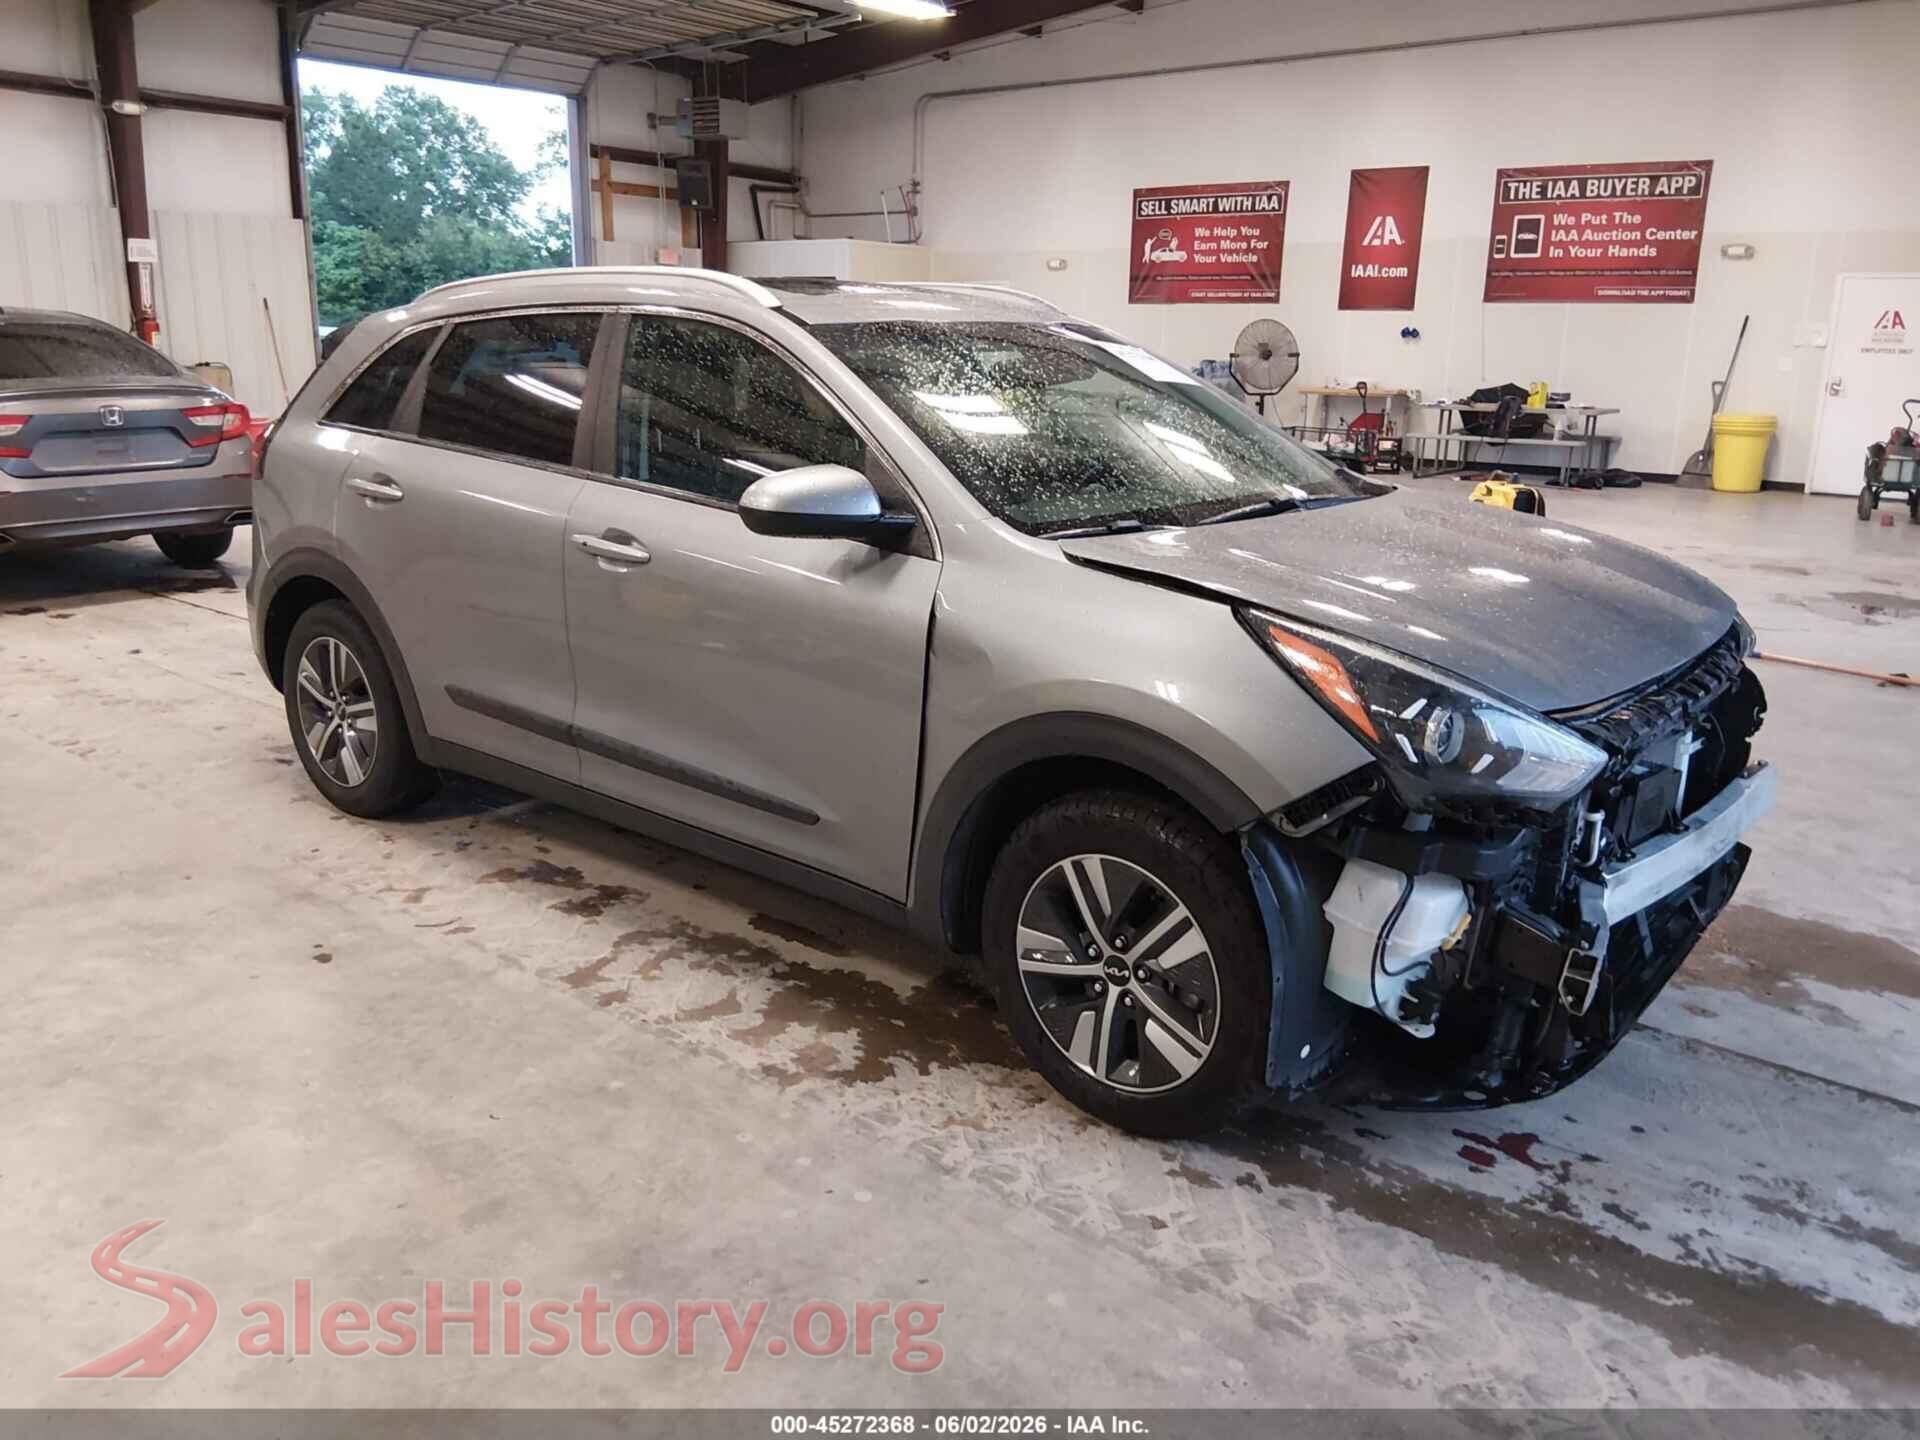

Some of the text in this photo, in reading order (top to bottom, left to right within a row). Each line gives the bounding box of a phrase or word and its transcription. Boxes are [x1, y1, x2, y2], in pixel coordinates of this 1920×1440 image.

[1507, 175, 1697, 201] THE IAA BUYER APP
[1140, 195, 1280, 216] SELL SMART WITH IAA
[1552, 212, 1643, 226] We Put The
[1194, 226, 1261, 239] We Help You
[1551, 227, 1699, 242] IAA Auction Center
[1193, 239, 1270, 251] Earn More For
[1549, 244, 1658, 258] In Your Hands
[1193, 252, 1259, 264] Your Vehicle
[1351, 264, 1408, 278] IAAI.com
